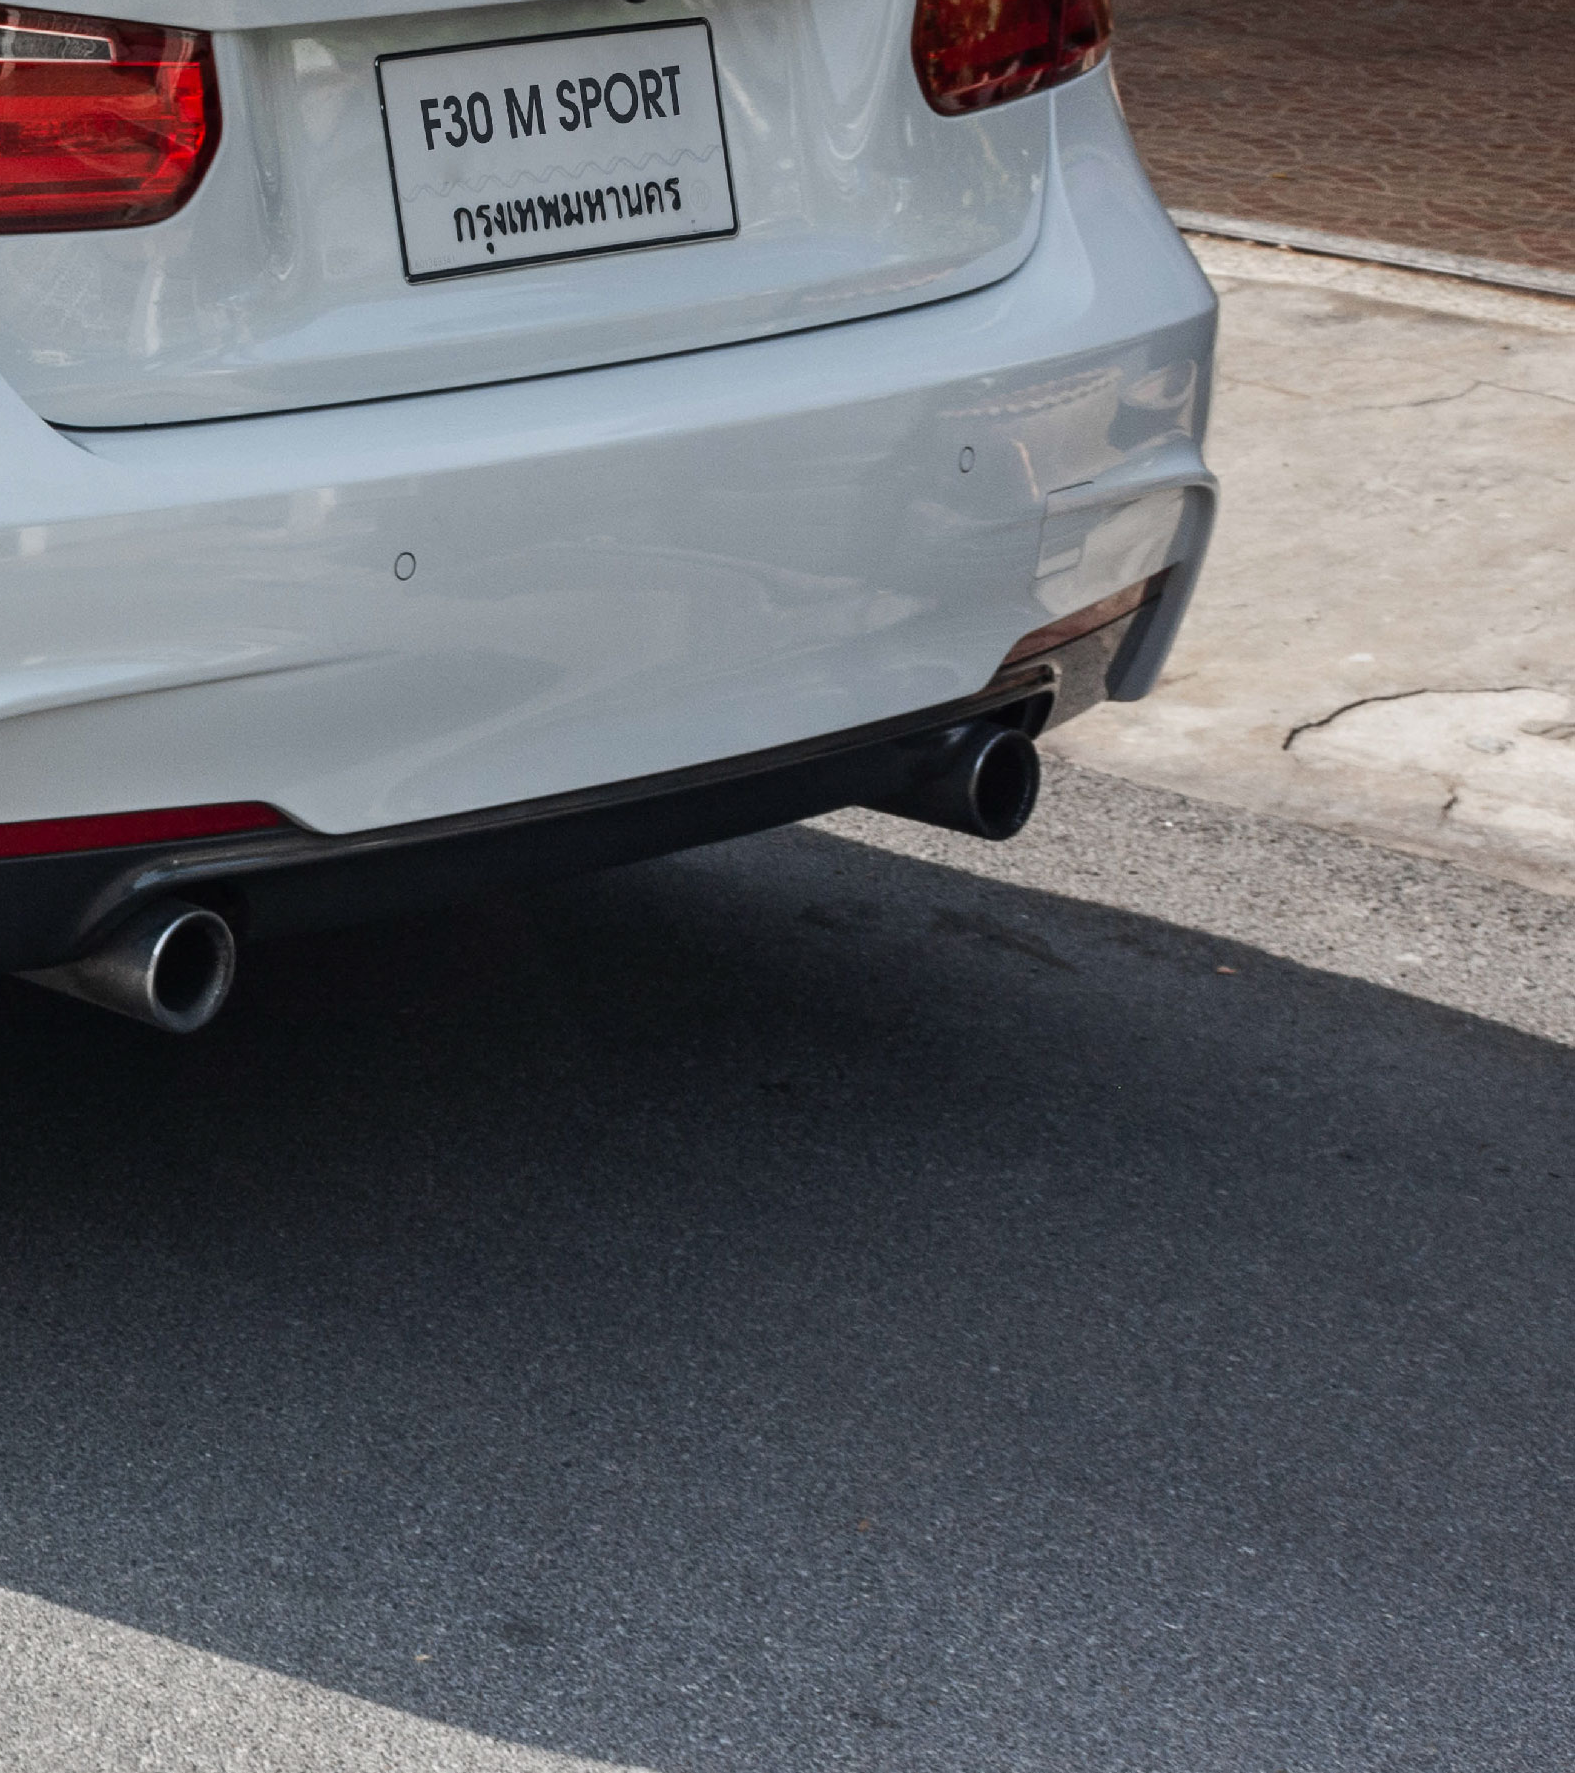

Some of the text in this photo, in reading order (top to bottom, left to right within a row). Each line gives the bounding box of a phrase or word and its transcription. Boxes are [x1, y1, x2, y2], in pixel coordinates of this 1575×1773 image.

[419, 64, 681, 151] F30 M SPORT
[452, 177, 682, 255] กรุงเทพมหานคร
